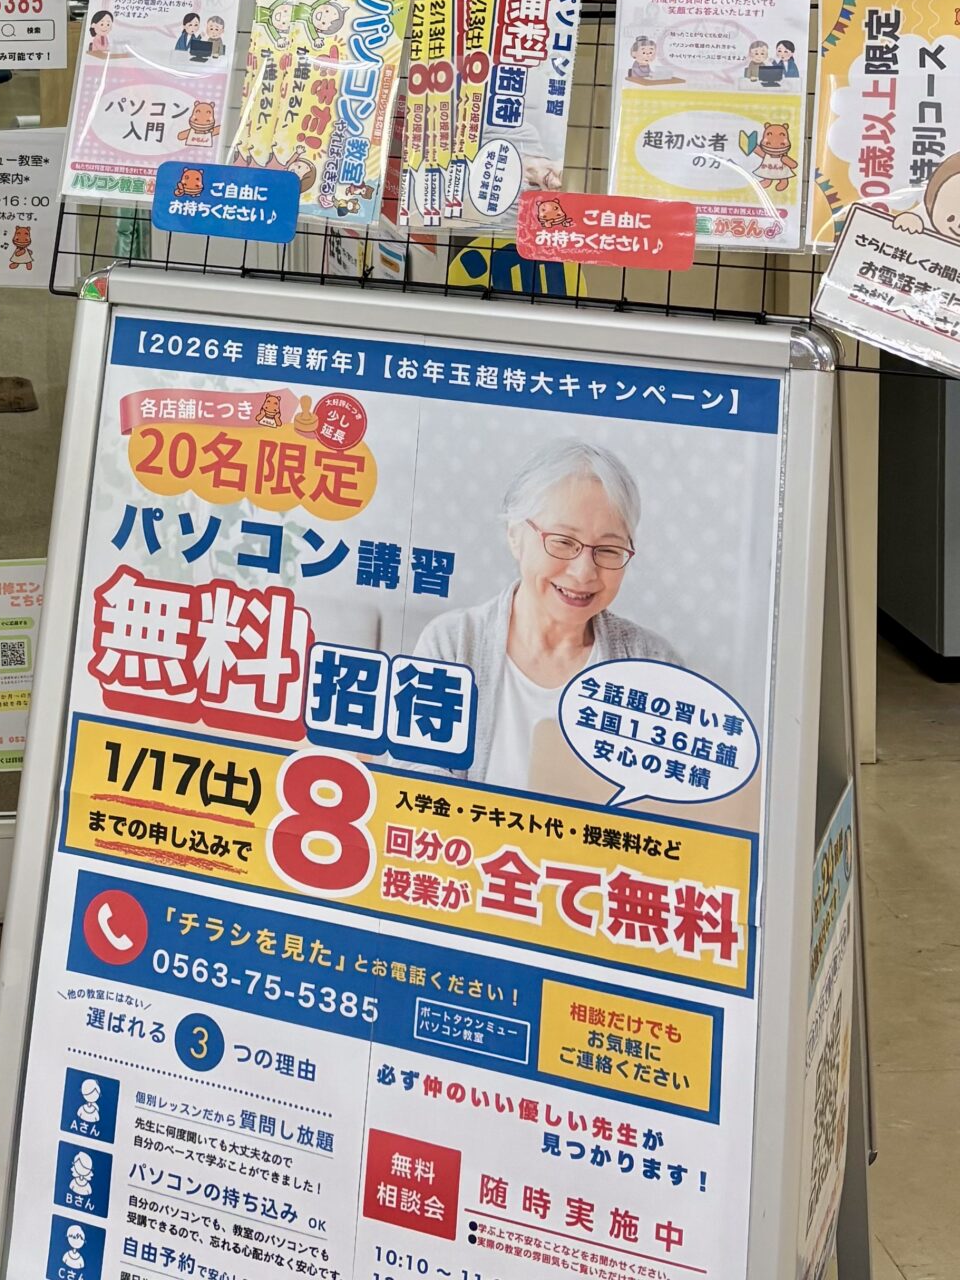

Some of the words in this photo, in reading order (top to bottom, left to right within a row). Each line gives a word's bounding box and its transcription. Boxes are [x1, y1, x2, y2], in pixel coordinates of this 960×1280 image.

[105, 100, 190, 119] パソコン
[495, 65, 528, 126] 招待
[859, 9, 901, 214] 0歳以上限定
[122, 121, 165, 143] 入門
[642, 129, 729, 153] 超初心者
[72, 173, 145, 194] パソコン教室
[209, 182, 269, 201] ご自由に
[478, 150, 493, 201] 安心の実績
[582, 209, 652, 230] ご自由に
[140, 397, 253, 420] 各店舗につき
[320, 423, 345, 445] 延長
[327, 409, 350, 428] 少し
[136, 427, 366, 508] 20名限定
[110, 503, 457, 600] パソコン講習
[93, 566, 308, 718] 無料
[310, 650, 474, 751] 招待
[577, 675, 746, 738] 今話題の習い事
[103, 740, 263, 816] 1/17(土)
[591, 738, 711, 792] 安心の実績
[87, 809, 254, 863] までの申し込みで
[268, 750, 376, 896] 8
[384, 824, 474, 868] 回分の
[394, 791, 683, 863] 入学金・テキスト代・授業料など
[382, 868, 470, 911] 授業が
[479, 850, 740, 963] 全て無料
[67, 988, 145, 1009] 他の教室にはない
[152, 949, 380, 1024] 0563-75-5385
[86, 1006, 167, 1044] 選ばれる
[190, 1026, 209, 1060] 3
[233, 1041, 317, 1083] つの理由
[418, 1019, 484, 1044] パソコン教室
[419, 1006, 518, 1037] ポートタウンミュー
[569, 1002, 682, 1044] 相談だけでも
[587, 1029, 661, 1061] お気軽に
[559, 1045, 690, 1091] ご連絡ください
[69, 1120, 101, 1138] Aさん
[376, 1063, 665, 1153] 必ず仲のいい優しい先生が
[134, 1117, 293, 1168] 先生に何度聞いても大丈夫なので
[390, 1151, 436, 1183] 無料
[541, 1131, 708, 1193] 見つかります！
[65, 1192, 96, 1212] Bさん
[128, 1162, 299, 1224] パソコンの持ち込み
[308, 1216, 327, 1232] OK
[376, 1181, 446, 1222] 相談会
[479, 1173, 685, 1254] 随時実施中
[126, 1211, 342, 1280] 受講できるので、忘れる心配がなく安心です。
[129, 1194, 330, 1262] 自分のパソコンでも、教室のパソコンでも
